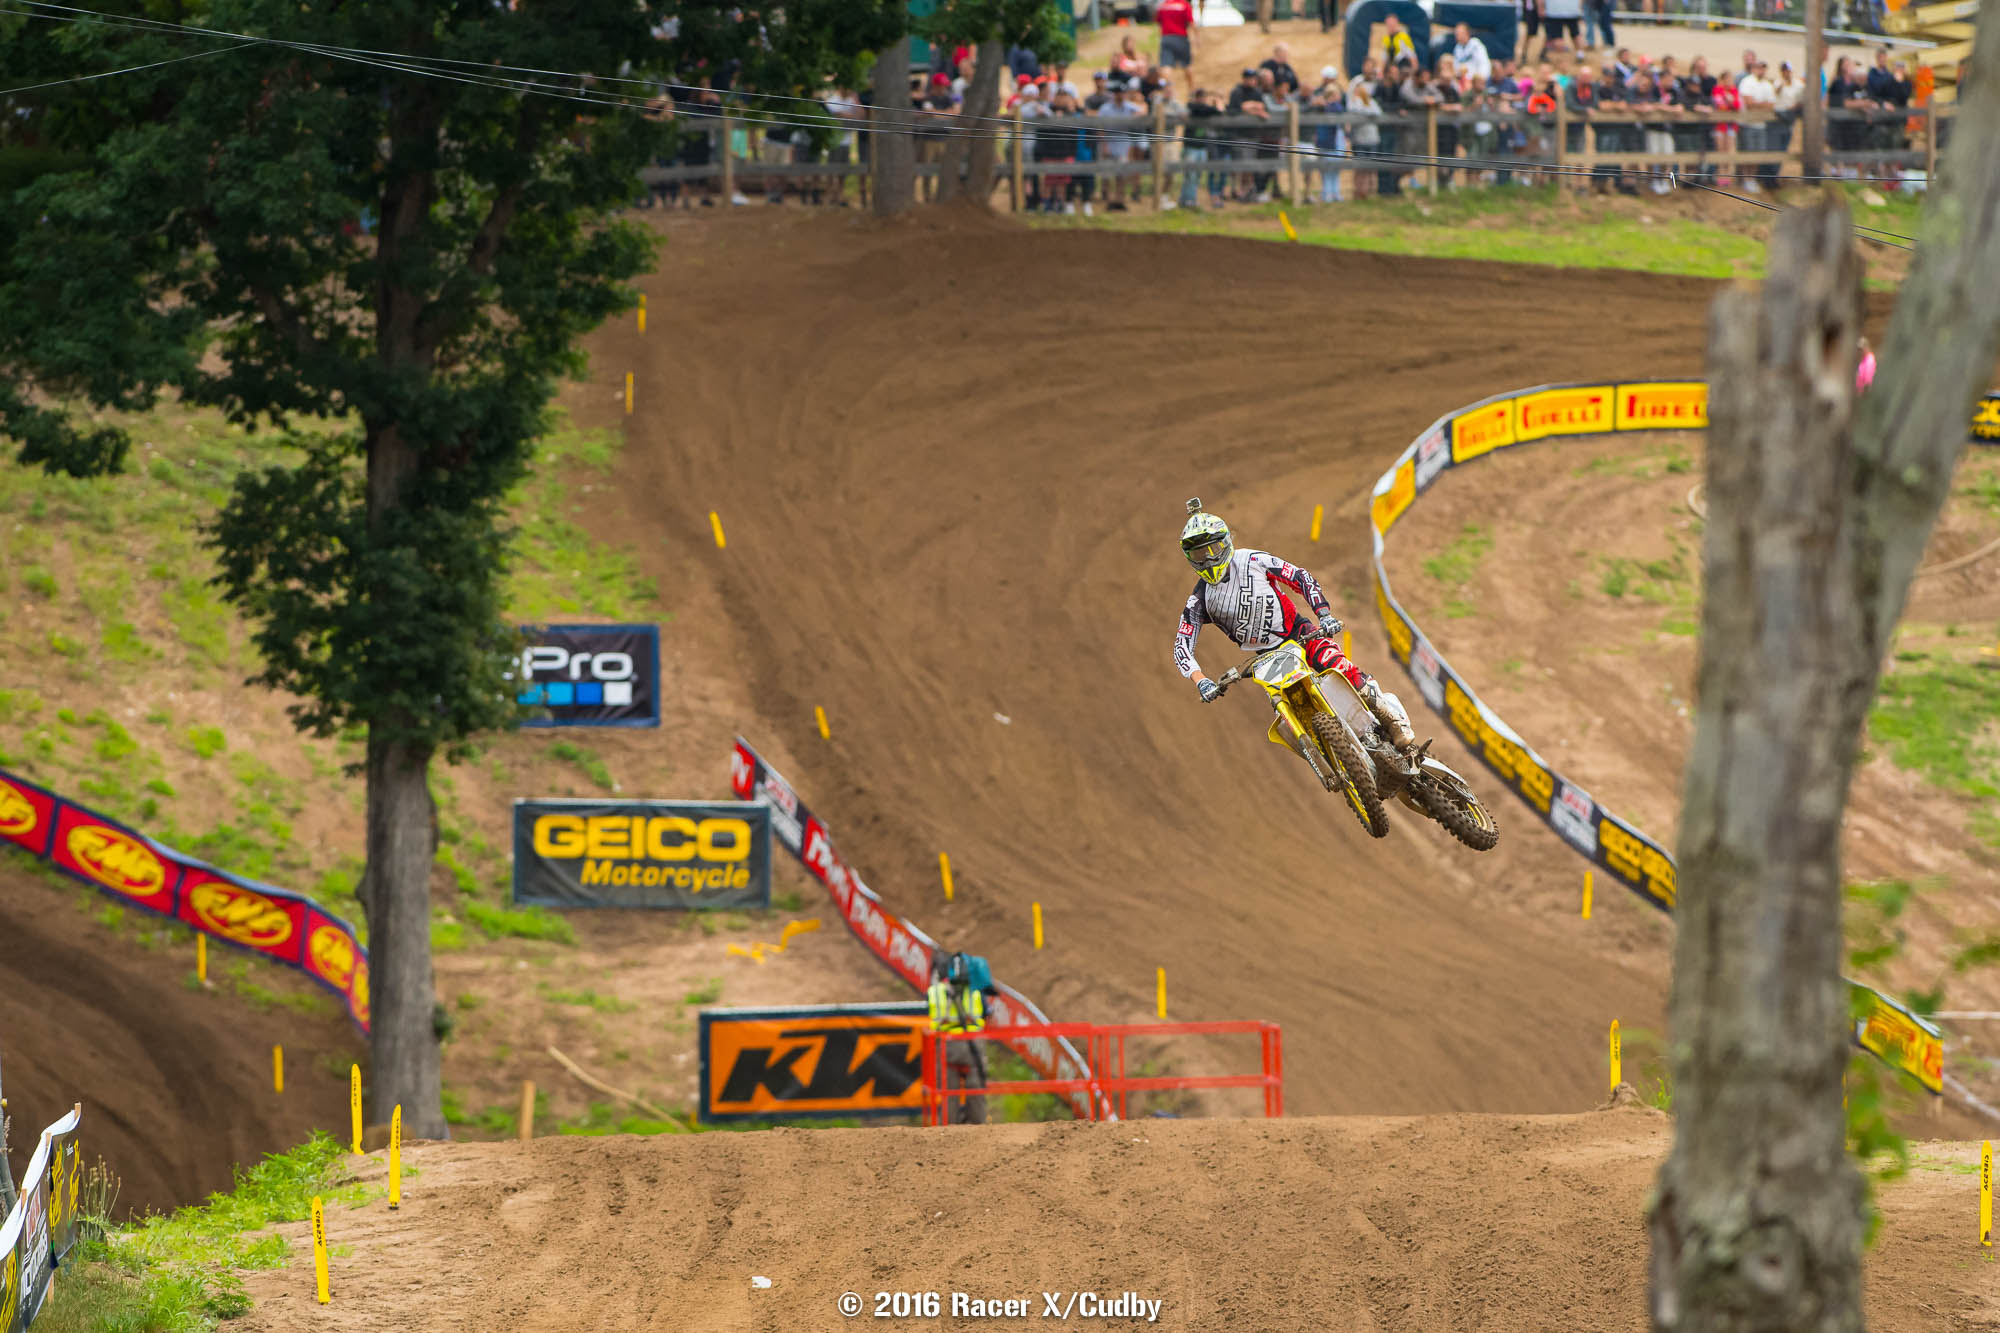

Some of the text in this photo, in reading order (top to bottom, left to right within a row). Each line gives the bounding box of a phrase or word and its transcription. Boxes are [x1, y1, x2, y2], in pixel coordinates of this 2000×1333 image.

[1627, 393, 1707, 418] PIREL
[1261, 595, 1275, 644] SUZUKI
[521, 646, 633, 680] Pro
[533, 814, 751, 862] GEICO
[580, 860, 750, 893] Motorcycle
[718, 1027, 924, 1103] KTM
